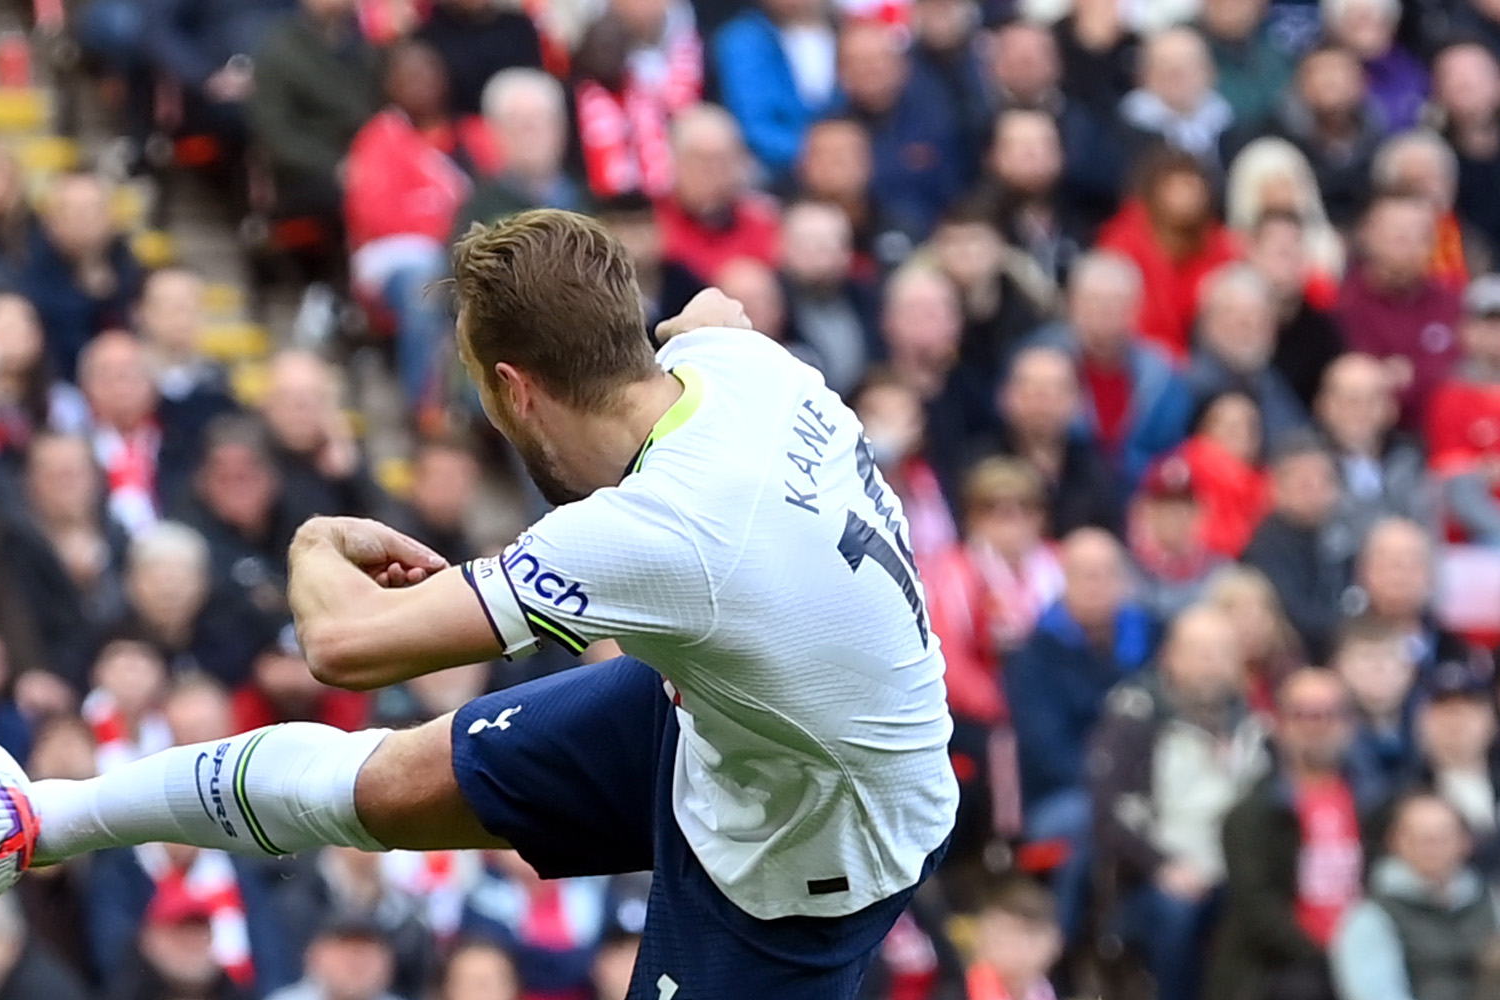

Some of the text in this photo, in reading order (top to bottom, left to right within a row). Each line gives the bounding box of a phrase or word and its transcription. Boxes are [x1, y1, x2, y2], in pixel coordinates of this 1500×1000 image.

[784, 399, 838, 516] KANE
[502, 534, 590, 617] inch
[210, 742, 238, 838] SPURS
